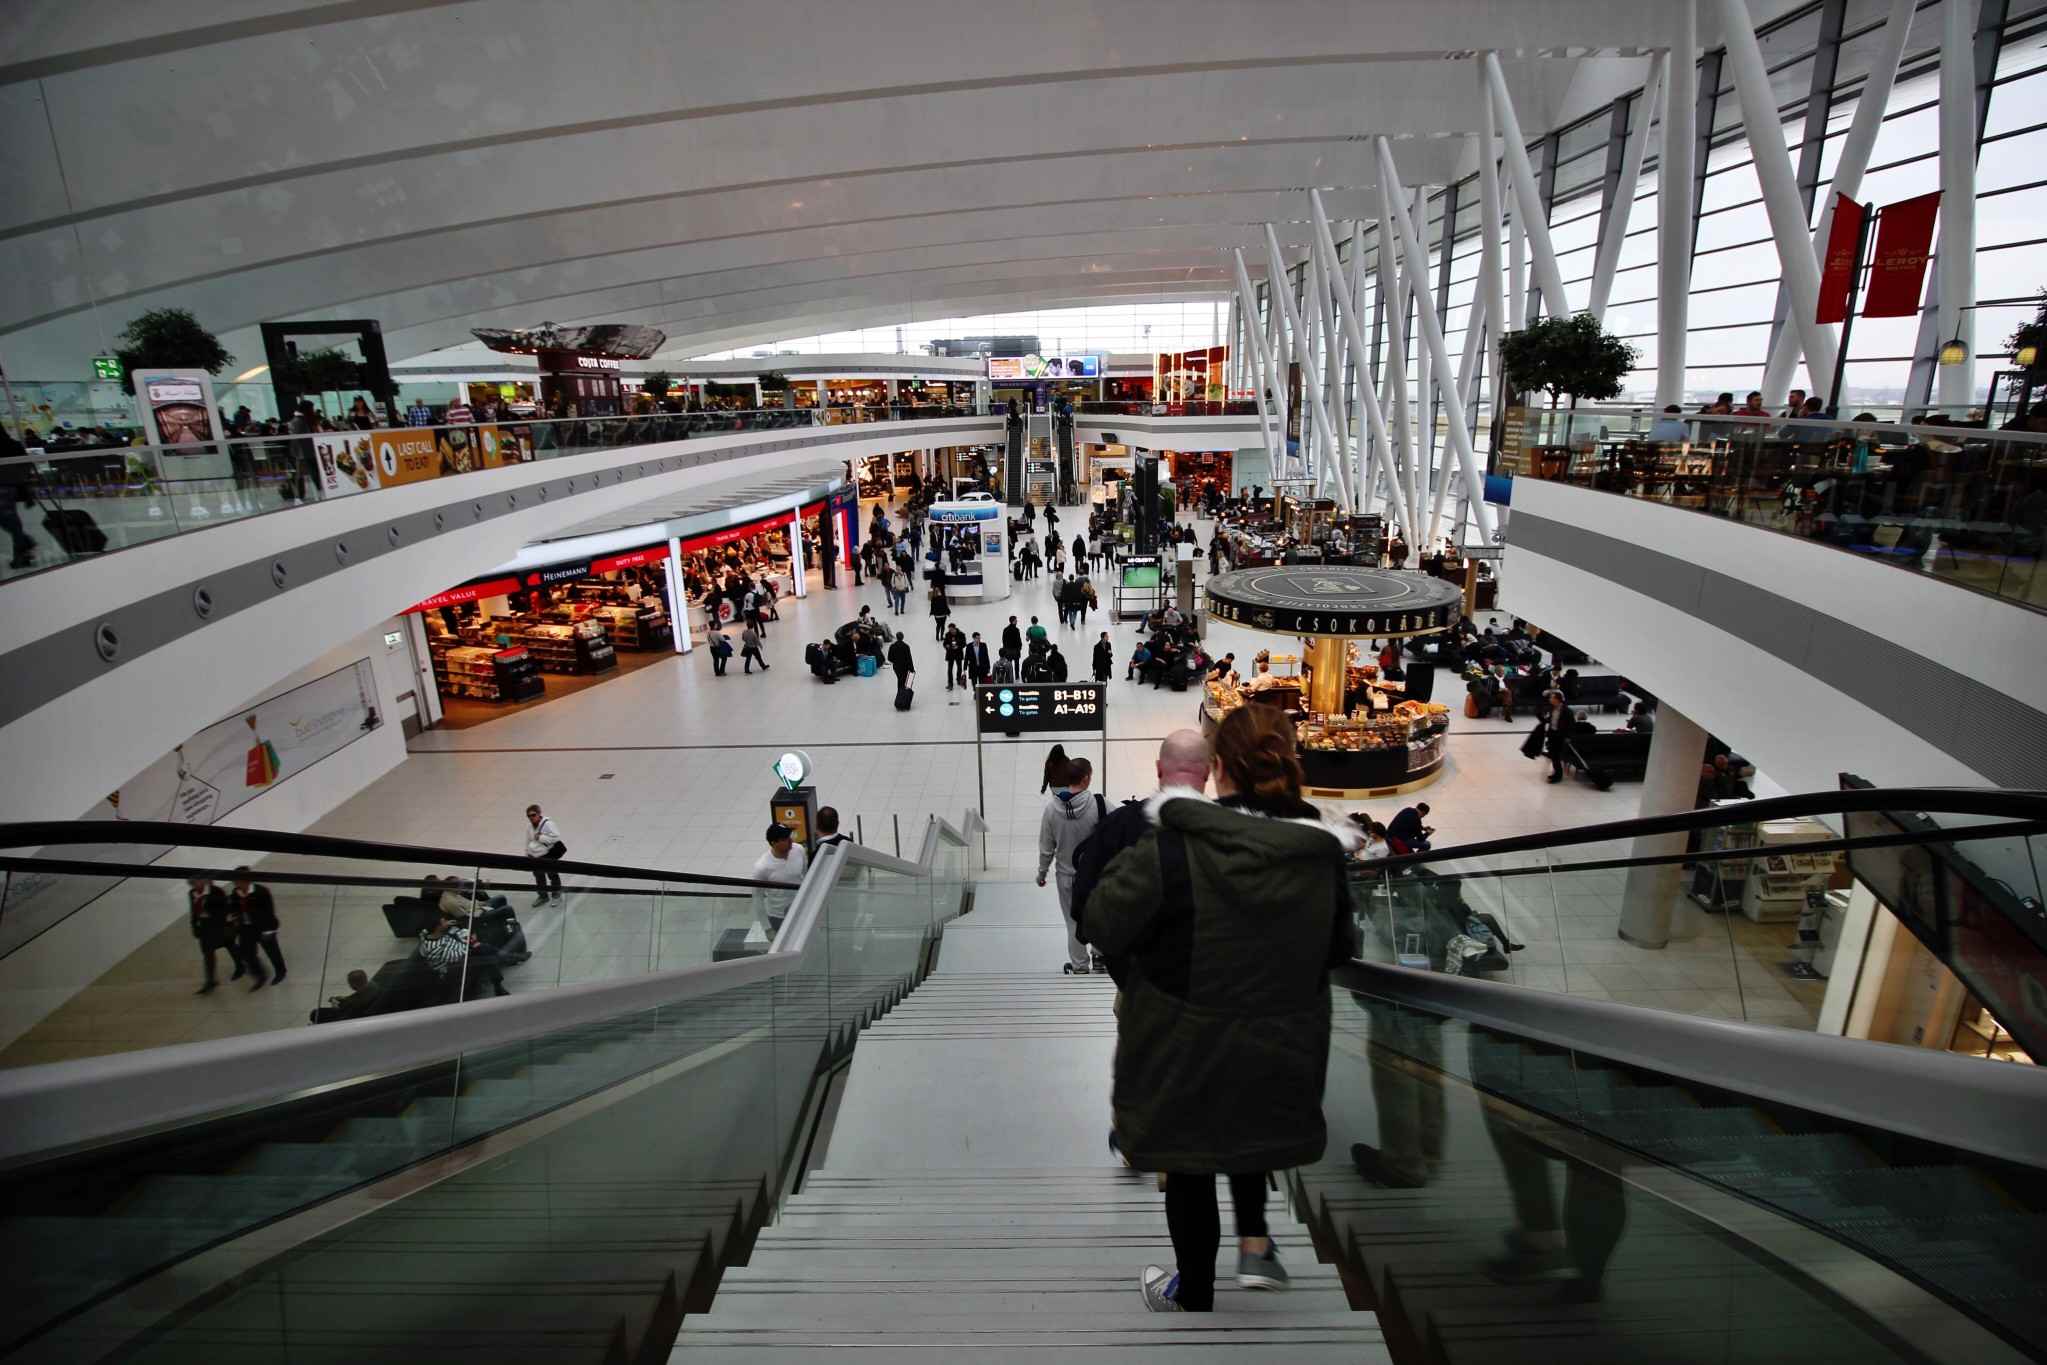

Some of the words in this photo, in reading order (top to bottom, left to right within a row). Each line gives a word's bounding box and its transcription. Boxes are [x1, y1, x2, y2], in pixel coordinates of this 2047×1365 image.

[578, 357, 599, 368] COSTA
[600, 358, 621, 369] COFFEE
[397, 441, 415, 456] LAST
[415, 439, 433, 454] CALL
[941, 511, 976, 521] citibank
[543, 566, 587, 582] HEINEMANN
[450, 590, 477, 600] VALUE
[1054, 689, 1096, 700] B1-B19
[1054, 703, 1096, 714] A1-A19
